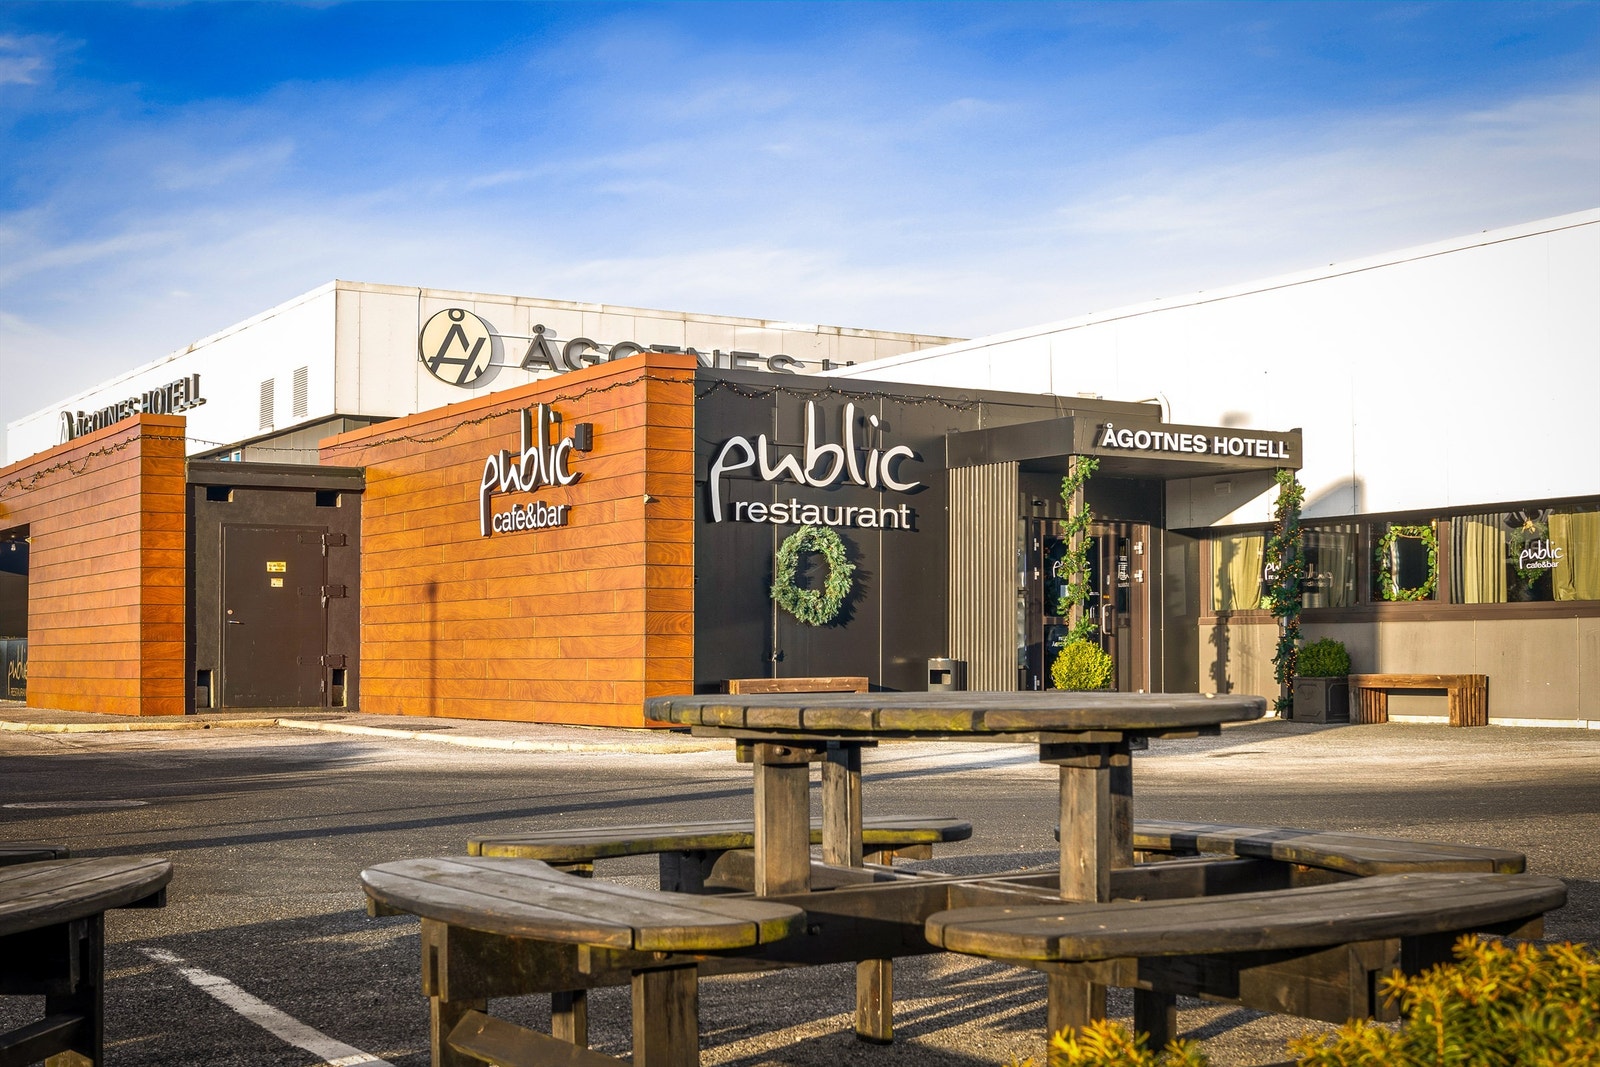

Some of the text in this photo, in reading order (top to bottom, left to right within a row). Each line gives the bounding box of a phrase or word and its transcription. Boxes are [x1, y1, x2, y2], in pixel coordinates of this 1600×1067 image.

[141, 373, 206, 415] HOTELL
[1102, 423, 1290, 459] ÅGOTNES HOTELL
[480, 402, 582, 537] public
[710, 400, 921, 523] public
[493, 500, 567, 533] cafe&bar
[735, 498, 911, 529] restaurant
[1519, 539, 1564, 569] public
